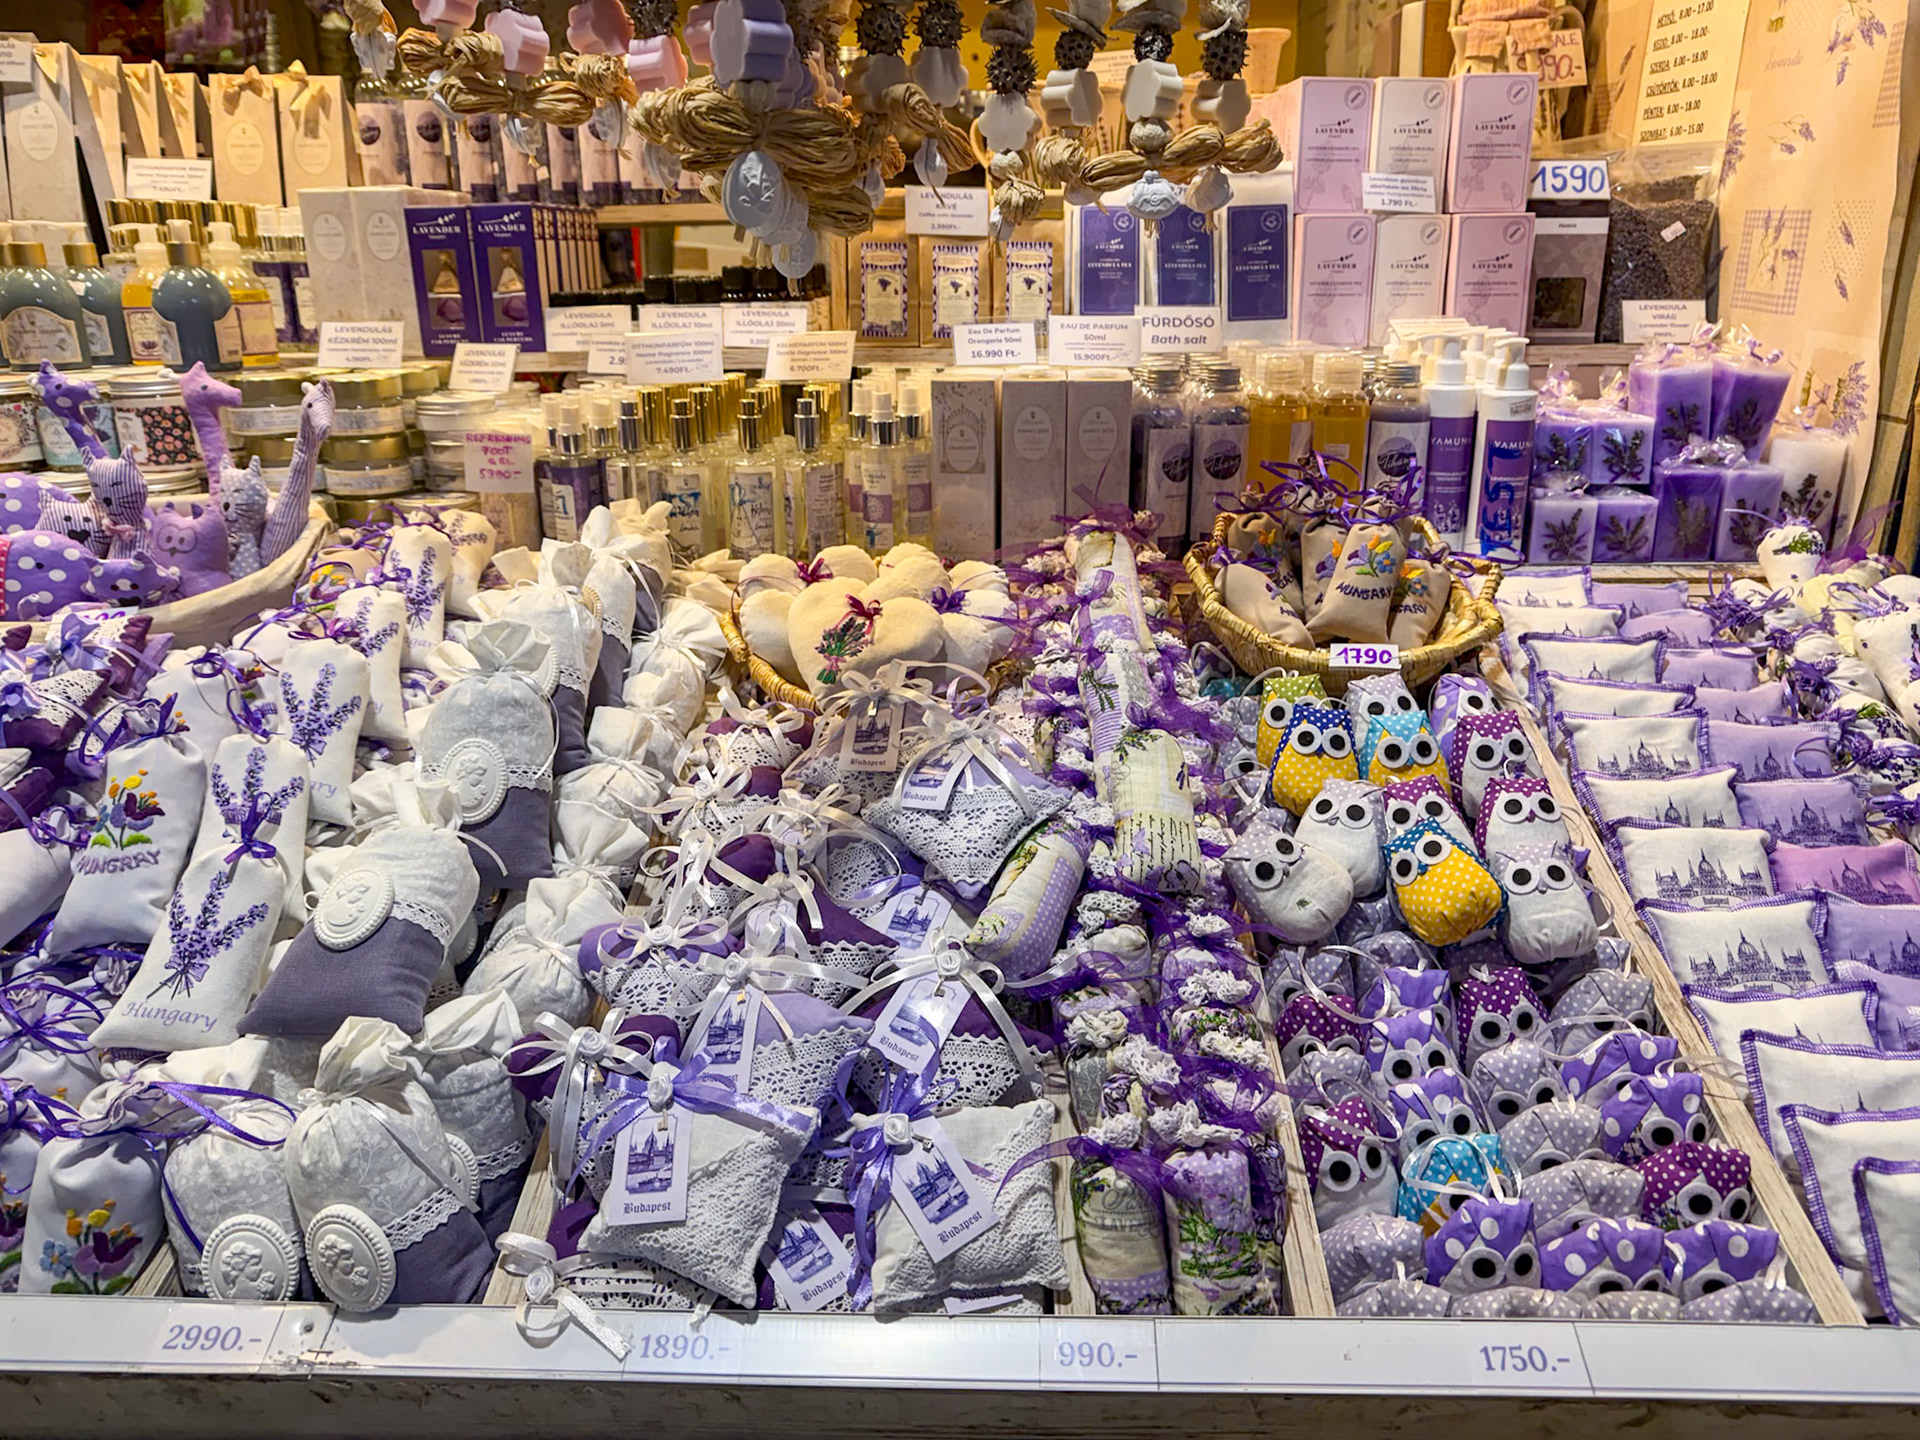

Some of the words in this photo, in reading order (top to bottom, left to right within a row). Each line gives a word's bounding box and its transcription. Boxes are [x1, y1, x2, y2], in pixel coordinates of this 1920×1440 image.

[1530, 164, 1606, 194] 1590
[920, 190, 974, 200] LEVNDULÁS
[412, 226, 462, 234] LAVENDER
[477, 223, 527, 232] LAVENDER
[656, 311, 707, 319] LEVENDULA
[742, 309, 790, 317] LEVENDULA
[1142, 314, 1215, 328] FÜRDŐSÓ
[967, 337, 1002, 345] Orangerie
[1083, 333, 1107, 341] 50ml
[1151, 334, 1181, 344] Bath
[1184, 334, 1208, 344] salt
[971, 350, 1003, 358] 16.990
[487, 457, 515, 466] GEL
[1336, 581, 1394, 601] HUNGARY
[1336, 646, 1393, 665] 1790
[850, 759, 887, 767] Budapest
[903, 790, 938, 802] Budapest
[121, 1001, 218, 1034] Hungary
[879, 1034, 920, 1063] Budapest
[623, 1201, 672, 1216] Budapest
[936, 1210, 984, 1246] Budapest
[800, 1269, 848, 1302] Budapest
[161, 1323, 263, 1352] 2990.-
[639, 1333, 731, 1361] 1890.-
[1058, 1340, 1138, 1369] 990.-
[1479, 1344, 1571, 1373] 1750.-
